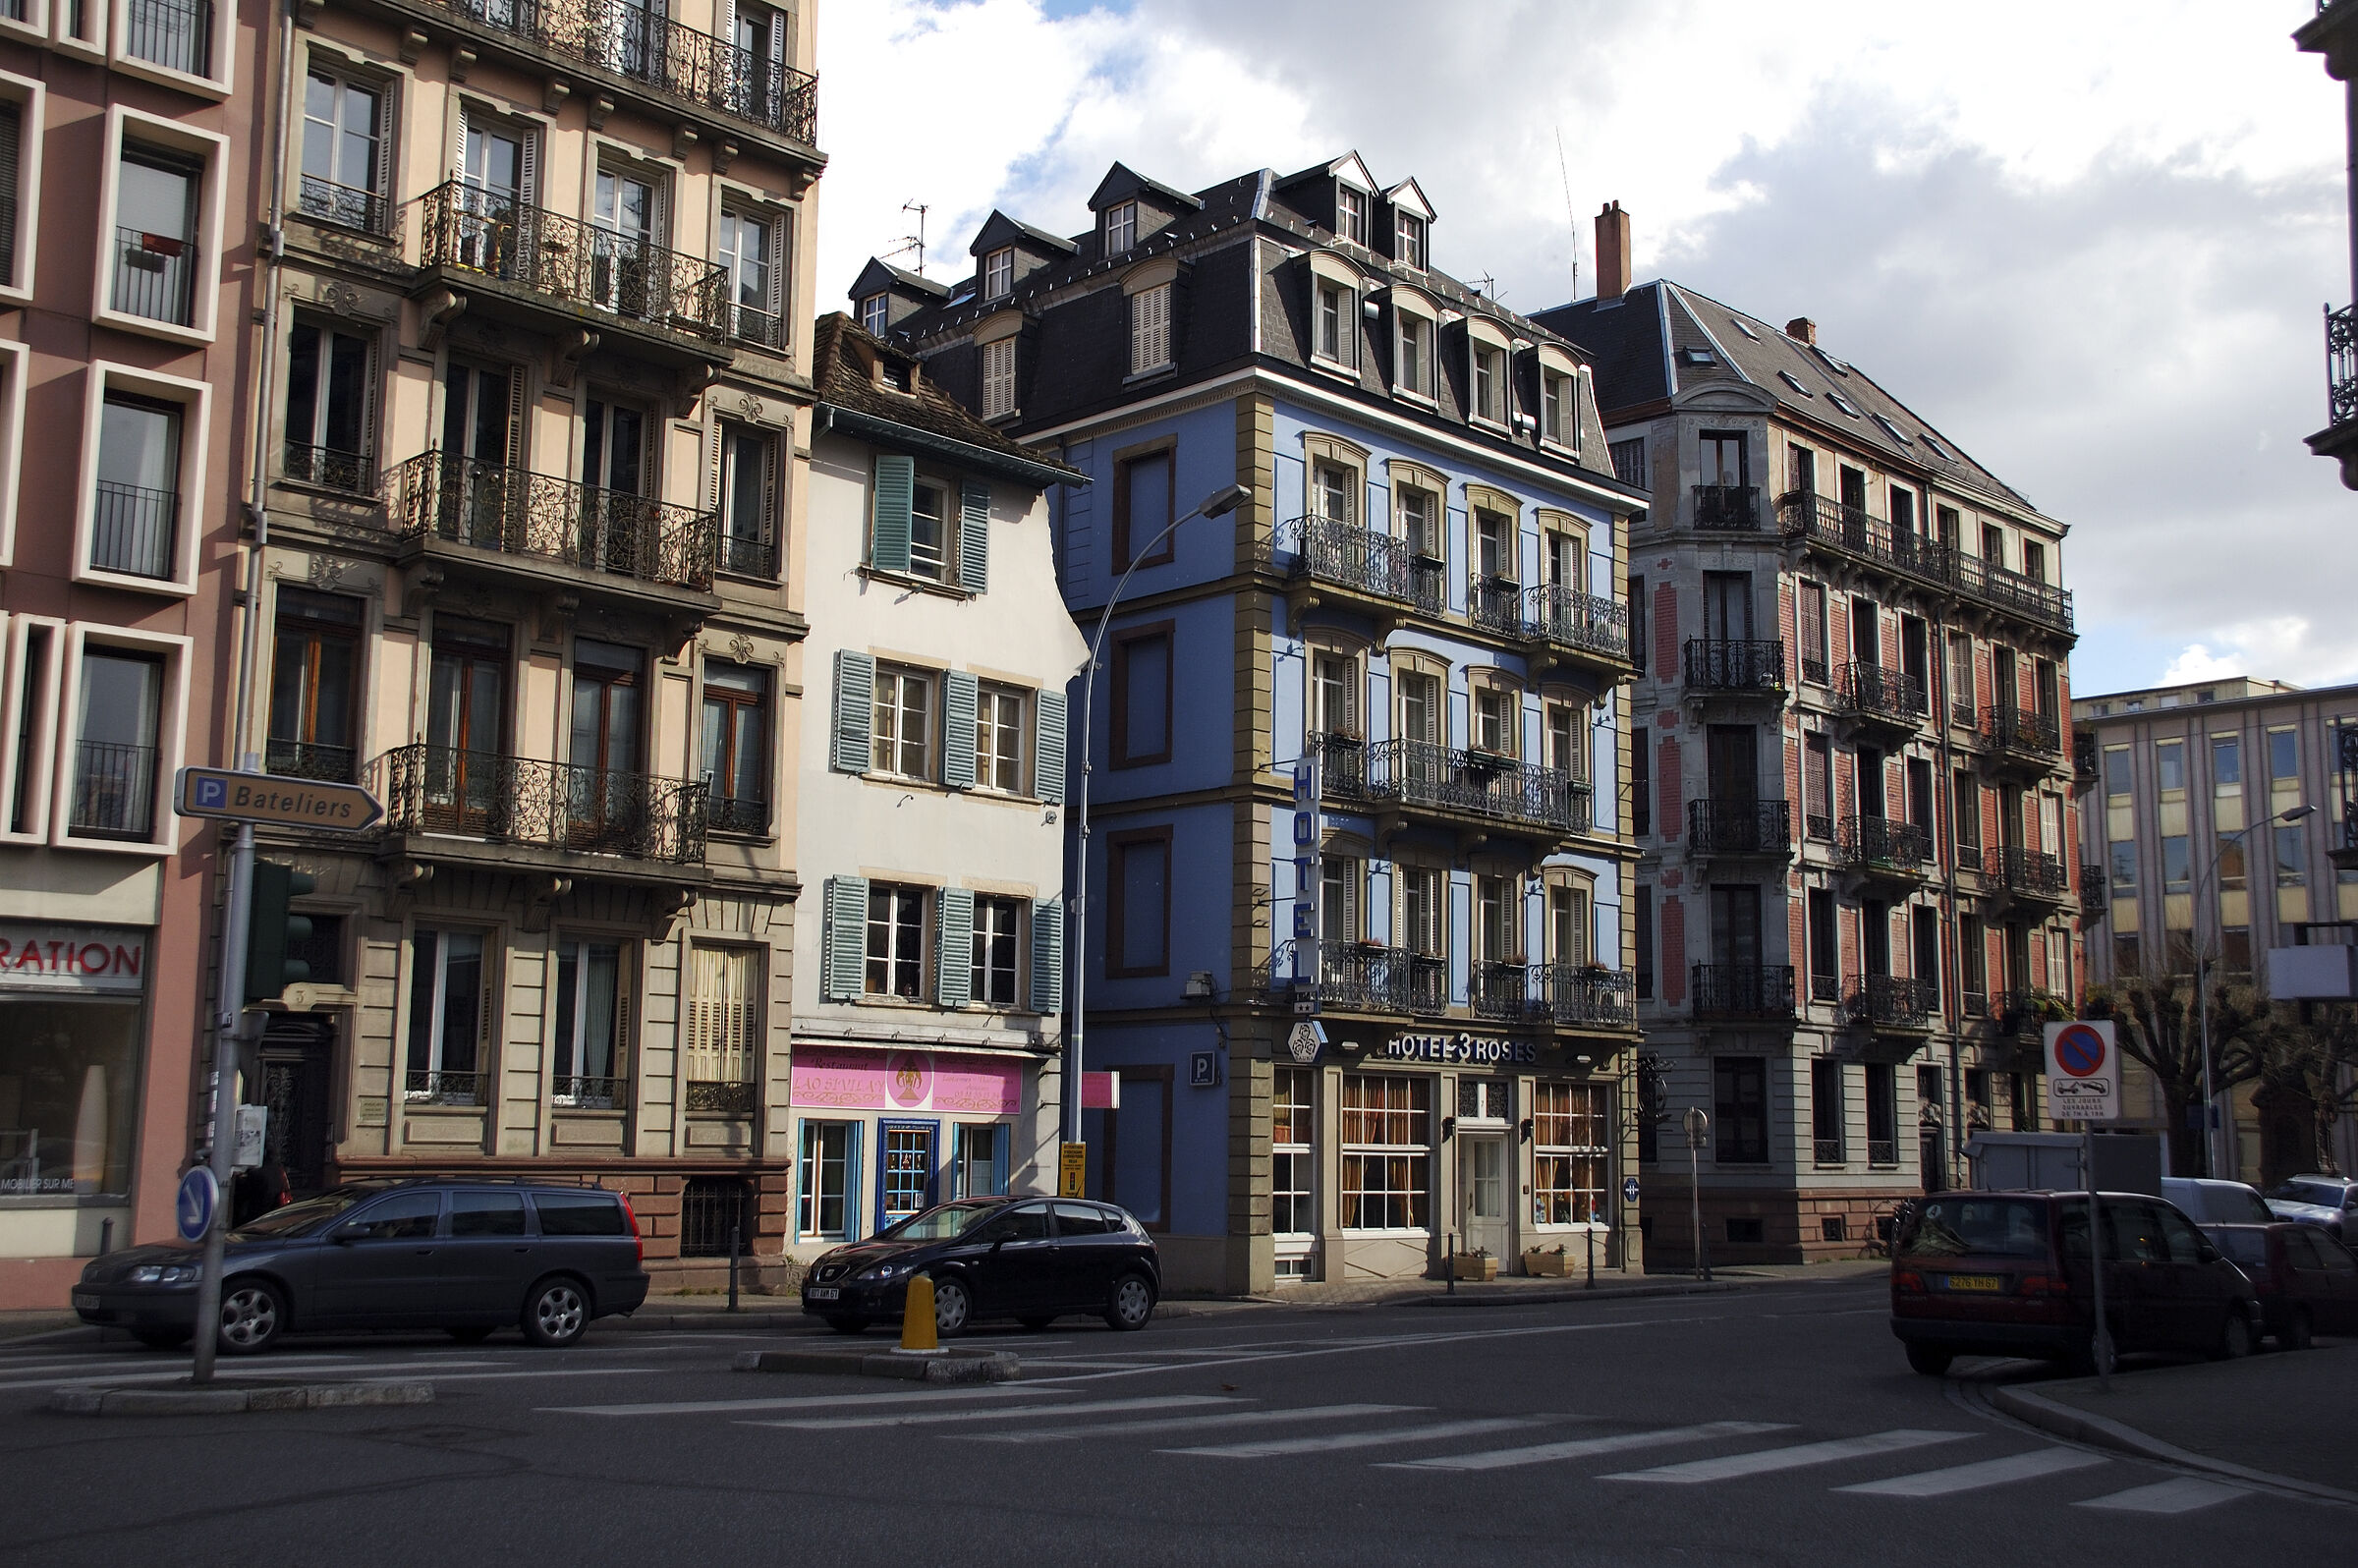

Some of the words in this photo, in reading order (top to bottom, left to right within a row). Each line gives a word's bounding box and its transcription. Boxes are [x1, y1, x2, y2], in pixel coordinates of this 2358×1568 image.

[202, 781, 221, 804] P
[235, 786, 352, 817] Bateliers
[1292, 764, 1315, 985] HOTEL
[0, 938, 141, 976] RATION
[1388, 1035, 1453, 1058] HOTEL
[1458, 1033, 1472, 1059] 3
[1476, 1039, 1537, 1062] ROSES
[1197, 1058, 1207, 1078] P
[793, 1076, 821, 1091] LAO
[1, 1179, 41, 1190] MOBILIER
[43, 1179, 60, 1189] SUR
[1985, 1278, 1996, 1288] 67
